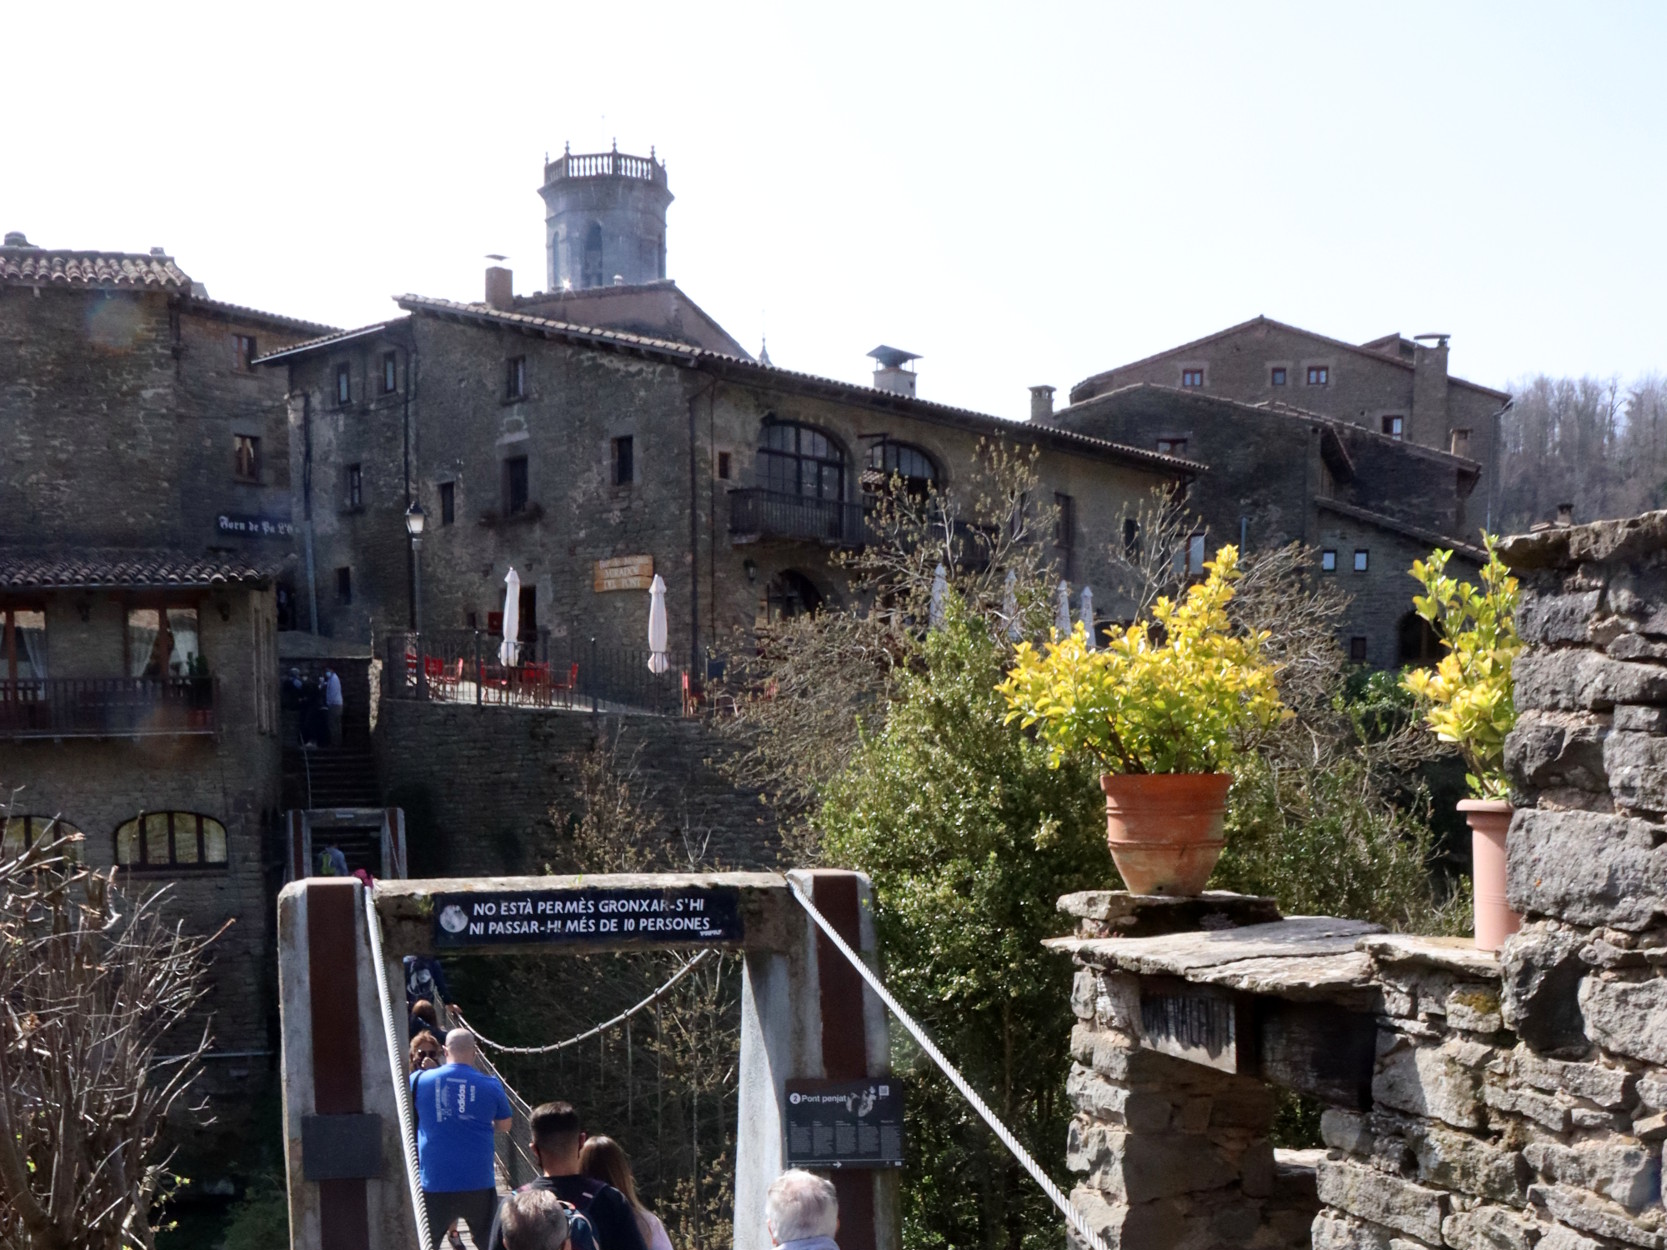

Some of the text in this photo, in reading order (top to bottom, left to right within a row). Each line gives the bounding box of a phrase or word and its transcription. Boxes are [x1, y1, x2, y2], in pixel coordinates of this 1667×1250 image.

[473, 897, 704, 916] NO ESTÀ PERMÈS GRONXAR-S'HI
[469, 922, 485, 935] NI
[565, 916, 596, 932] MÉS
[600, 919, 619, 932] DE
[639, 917, 710, 931] PERSONES
[457, 1083, 466, 1114] adidas
[801, 1094, 820, 1103] Pont
[821, 1094, 847, 1104] penjat
